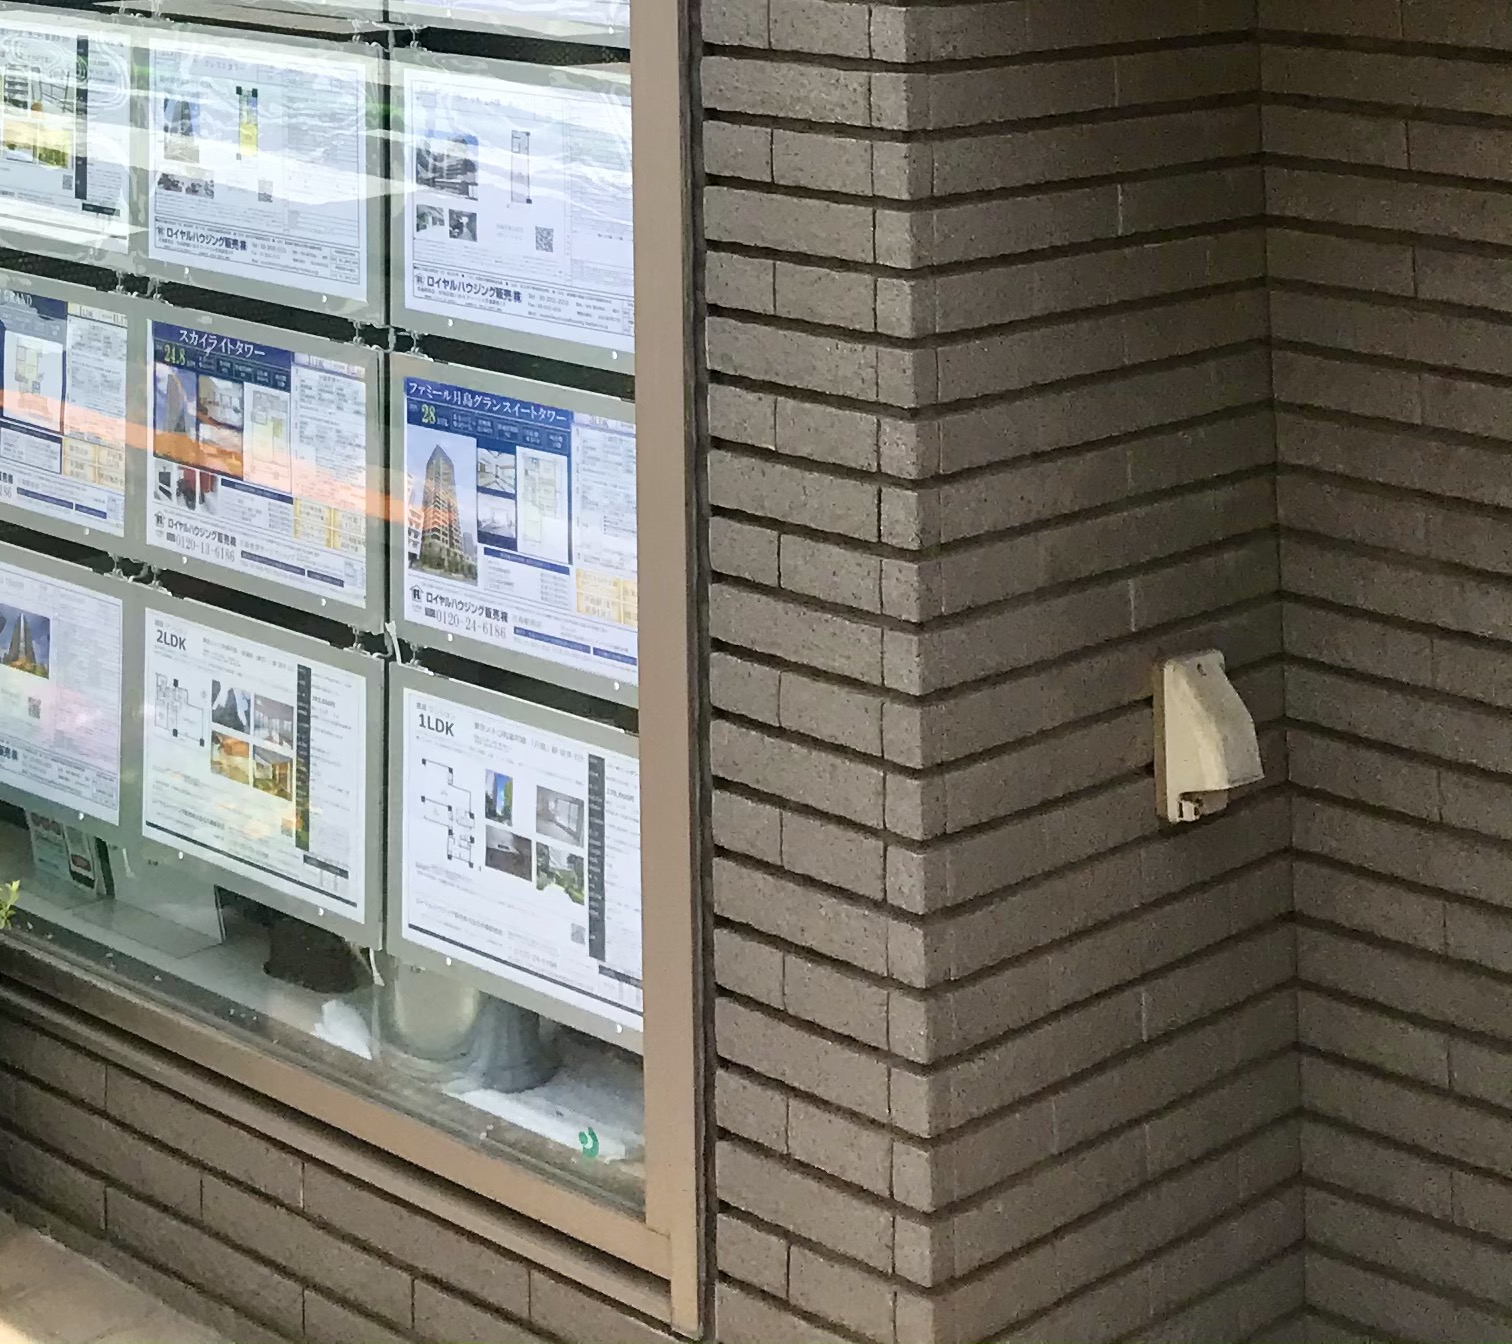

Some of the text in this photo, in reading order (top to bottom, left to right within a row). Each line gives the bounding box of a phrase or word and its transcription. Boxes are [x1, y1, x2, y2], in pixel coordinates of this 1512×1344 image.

[3, 288, 33, 306] GRAND
[179, 330, 266, 358] スカイライトタワー
[408, 380, 568, 424] ファミール月島グランスイートタワー
[421, 404, 436, 425] 28
[436, 609, 507, 640] 0120-24-6186
[157, 629, 187, 652] 2LDK
[418, 714, 455, 738] 1LDK
